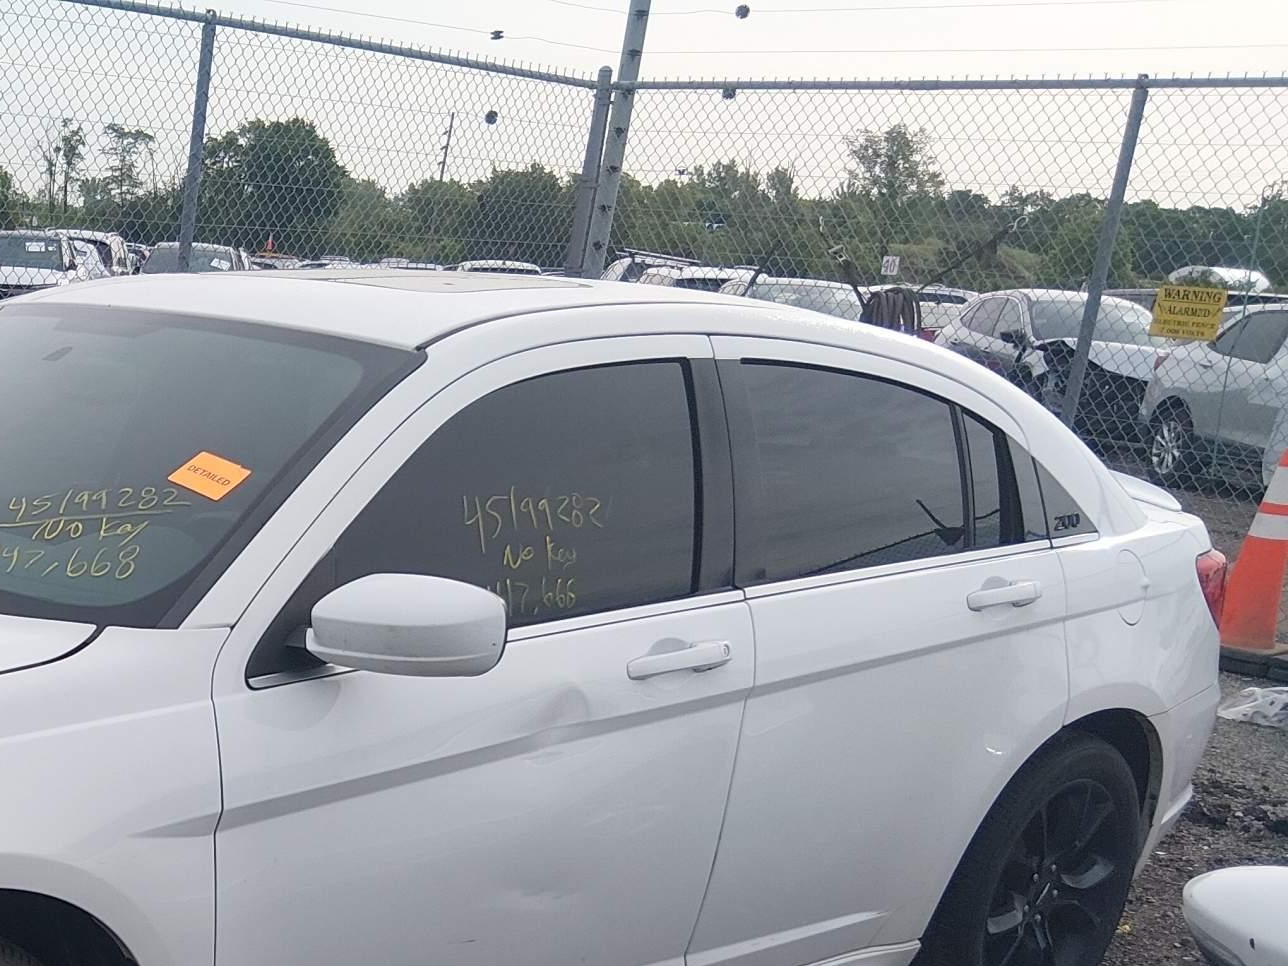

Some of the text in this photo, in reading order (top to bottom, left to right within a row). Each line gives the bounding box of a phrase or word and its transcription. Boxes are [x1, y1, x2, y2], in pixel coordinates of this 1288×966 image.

[1164, 287, 1222, 303] WARNING
[187, 464, 231, 487] DETAILED
[463, 485, 604, 554] 45199282
[504, 543, 535, 569] No
